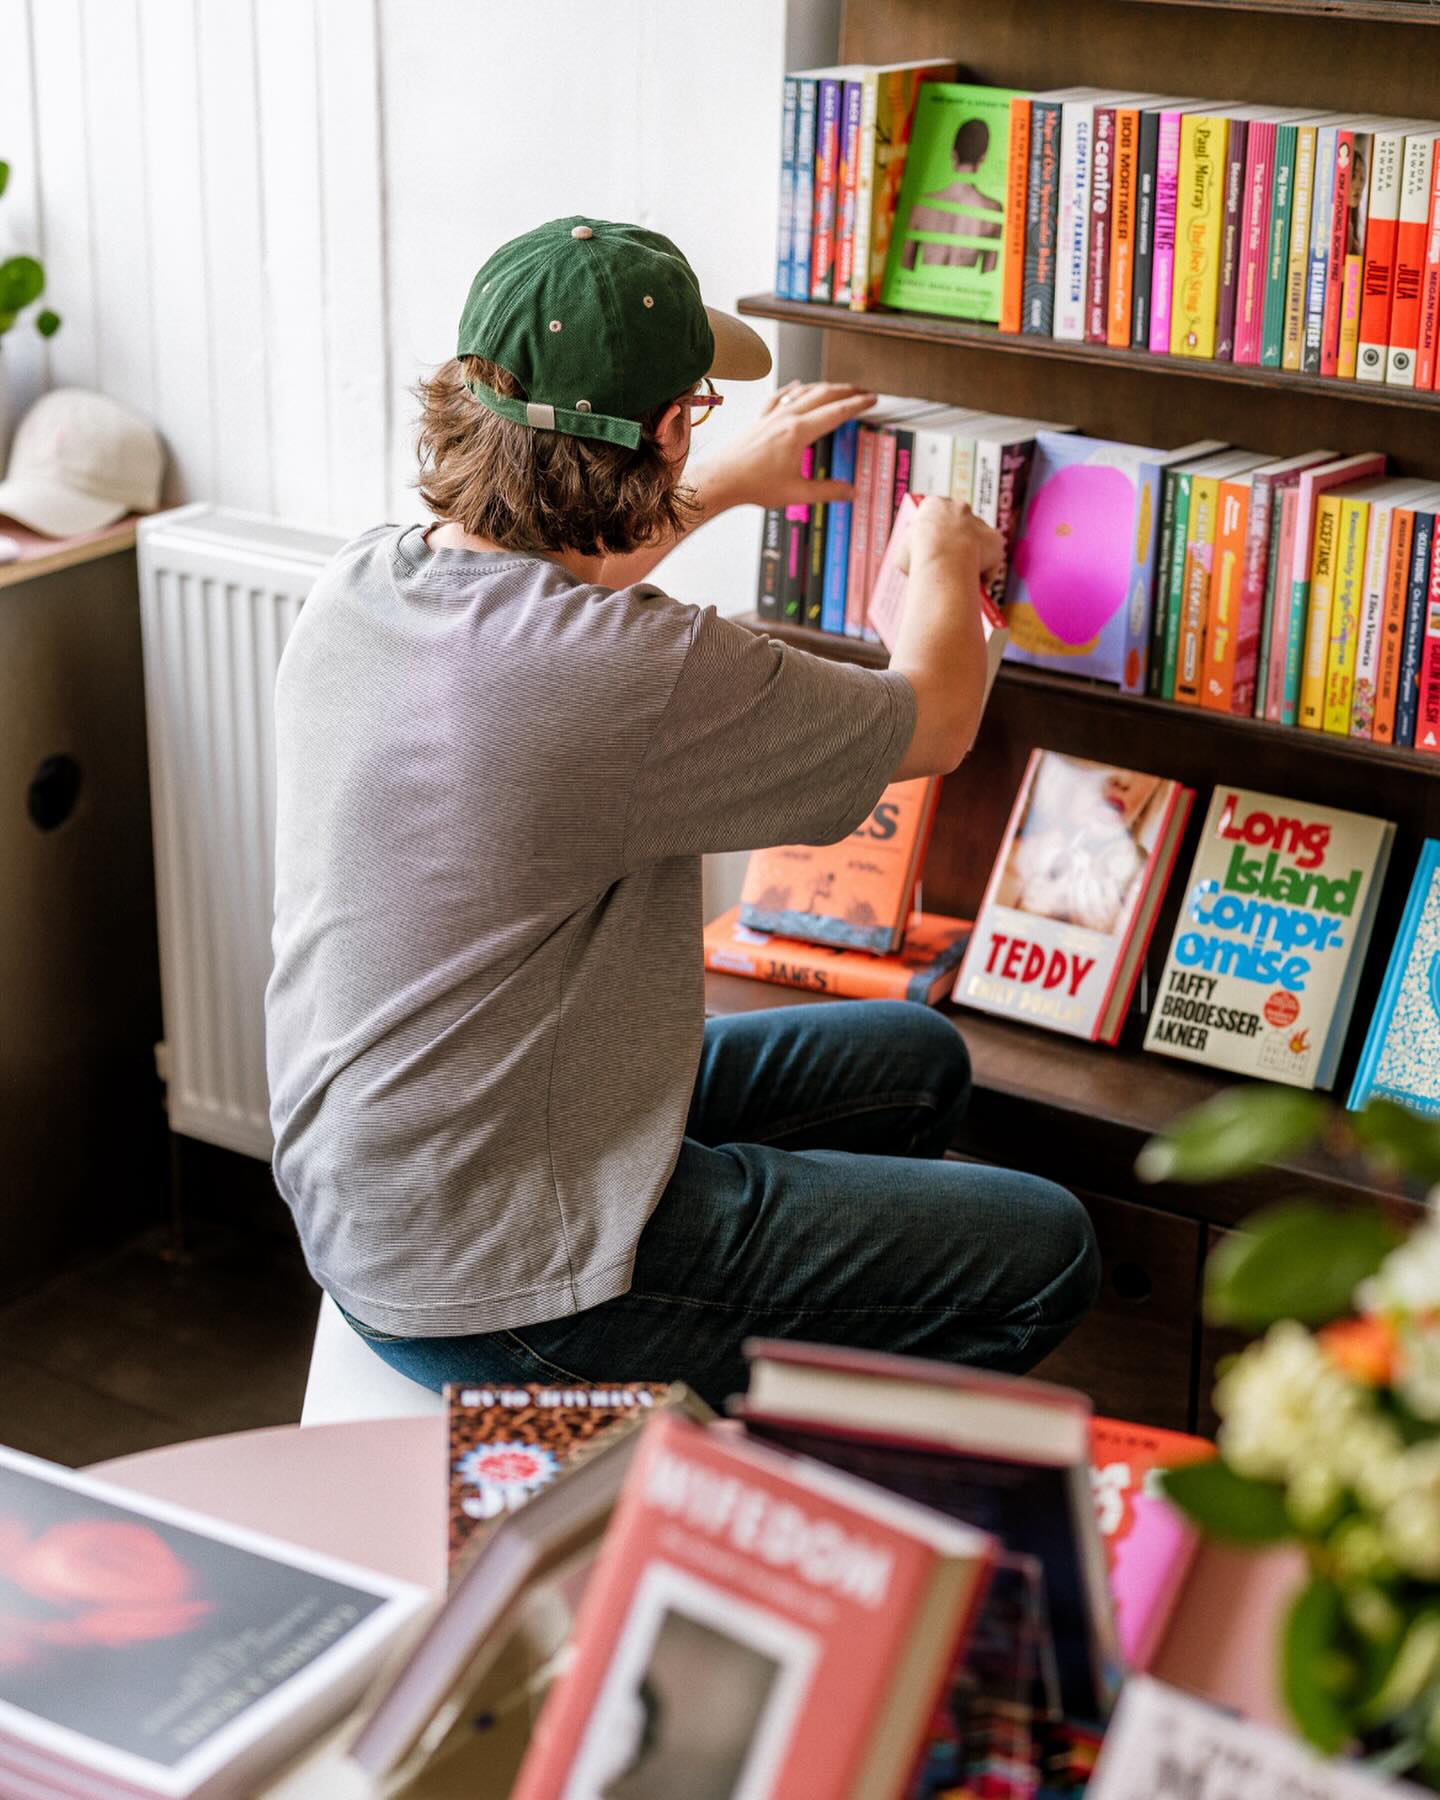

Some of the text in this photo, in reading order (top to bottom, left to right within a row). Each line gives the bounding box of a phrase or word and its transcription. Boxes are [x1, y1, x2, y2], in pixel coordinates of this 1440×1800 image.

[1097, 114, 1111, 139] the
[1075, 121, 1088, 190] CLEOPATRA
[1092, 140, 1111, 214] centre
[1118, 116, 1132, 240] BOB MORTIMER
[1191, 129, 1211, 210] Paul Murray
[1376, 140, 1387, 192] NEWMAN
[1385, 141, 1396, 189] SANDRA
[1407, 143, 1418, 196] NEWMAN
[1415, 144, 1427, 193] SANDRA
[1191, 223, 1206, 245] The
[1071, 215, 1084, 303] FRANKENSTEIN
[1365, 260, 1390, 297] JULIA
[1396, 263, 1420, 300] JULIA
[1291, 271, 1303, 313] BENJAMIN
[1309, 261, 1326, 313] BENJAMIN
[1427, 270, 1438, 310] MEGAN
[1424, 312, 1435, 351] NOLAN
[1316, 511, 1334, 577] ACCEPTANCE
[1362, 623, 1377, 668] Victoria
[1426, 682, 1440, 724] WALSH
[1219, 795, 1331, 869] Long
[1223, 844, 1363, 917] Island
[769, 960, 827, 990] JAMES
[985, 934, 1095, 997] TEDDY
[1168, 971, 1217, 1001] TAFFY
[1153, 1021, 1208, 1051] AKNER
[1161, 994, 1262, 1037] BRODESSER-
